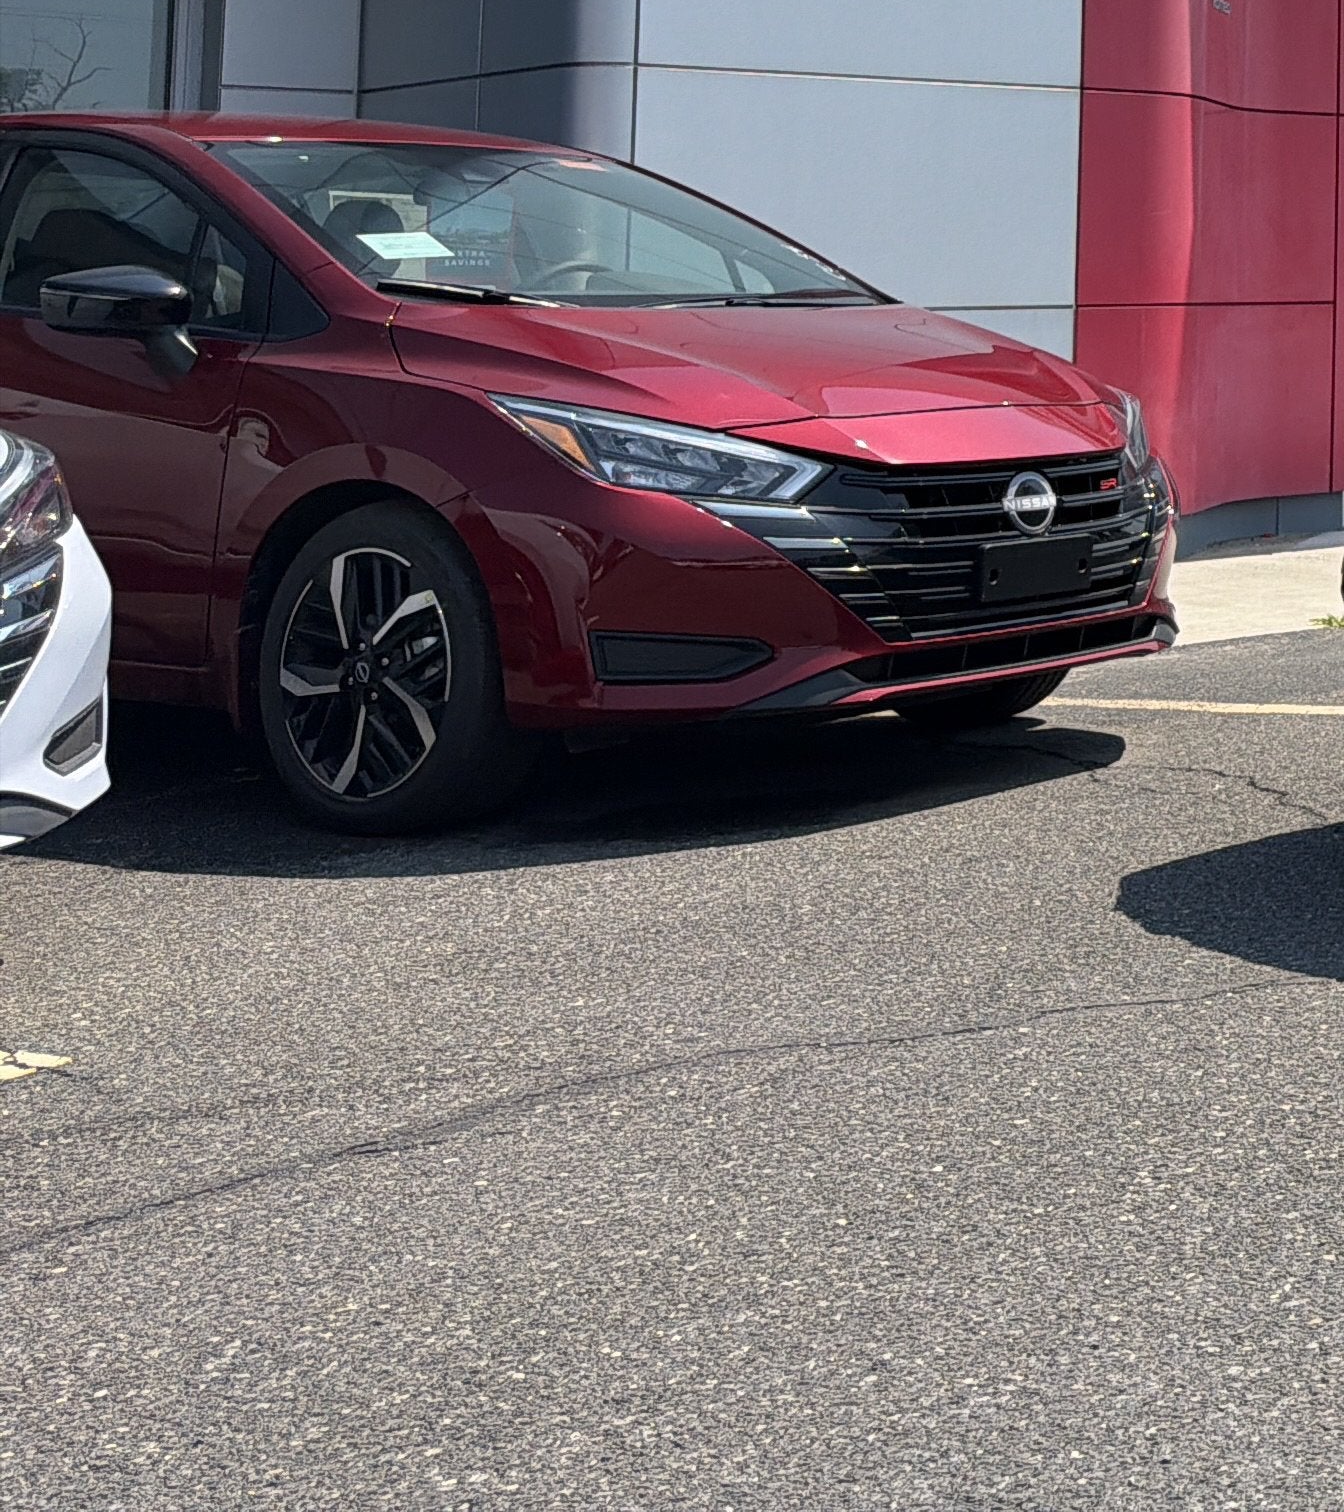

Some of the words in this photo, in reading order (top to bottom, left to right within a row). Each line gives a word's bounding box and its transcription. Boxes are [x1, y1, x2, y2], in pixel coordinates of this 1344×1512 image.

[449, 250, 486, 258] XTRA
[444, 259, 490, 267] SAVINGS
[1004, 496, 1057, 510] NISSAN
